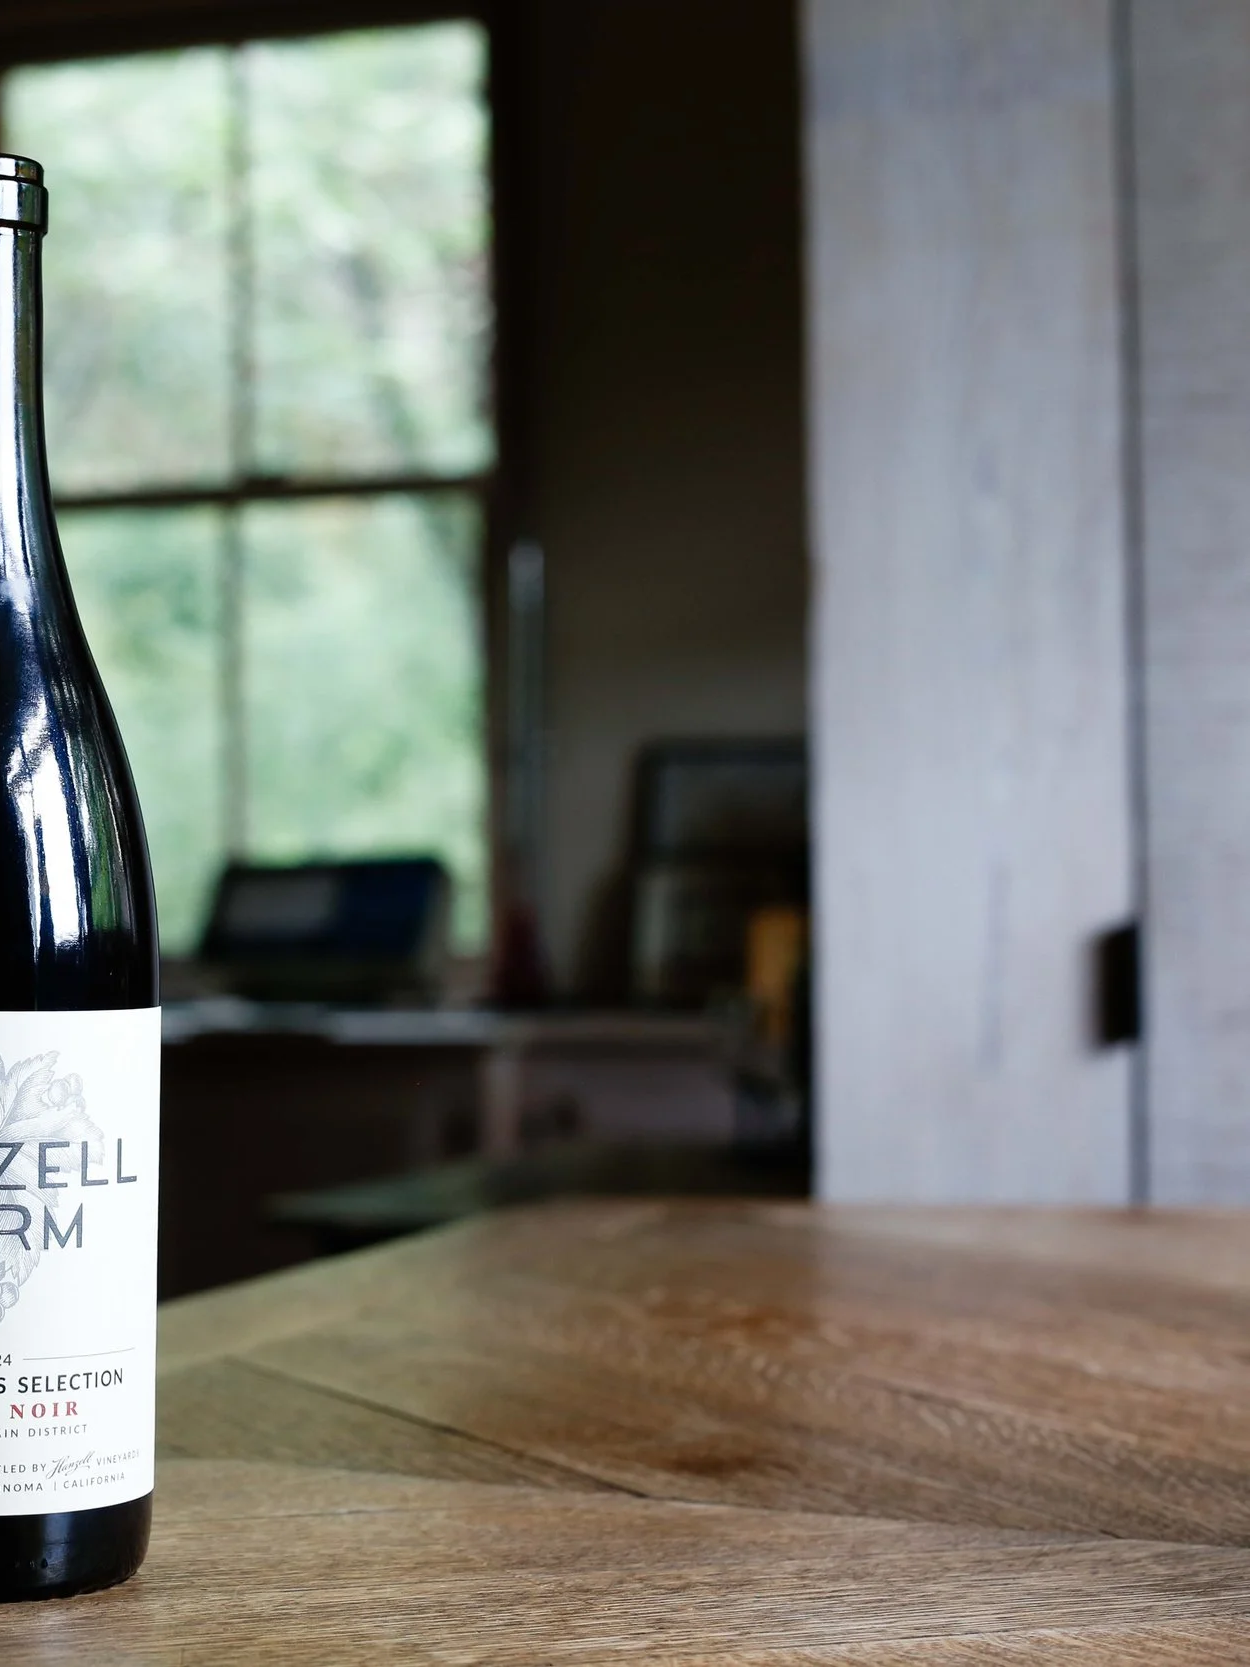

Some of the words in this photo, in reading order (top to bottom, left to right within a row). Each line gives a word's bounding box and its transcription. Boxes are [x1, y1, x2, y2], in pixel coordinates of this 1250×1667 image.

[17, 1367, 124, 1394] SELECTION
[9, 1400, 79, 1420] NOIR
[28, 1423, 88, 1438] DISTRICT
[32, 1463, 47, 1473] BY
[63, 1471, 126, 1490] CALIFORNIA
